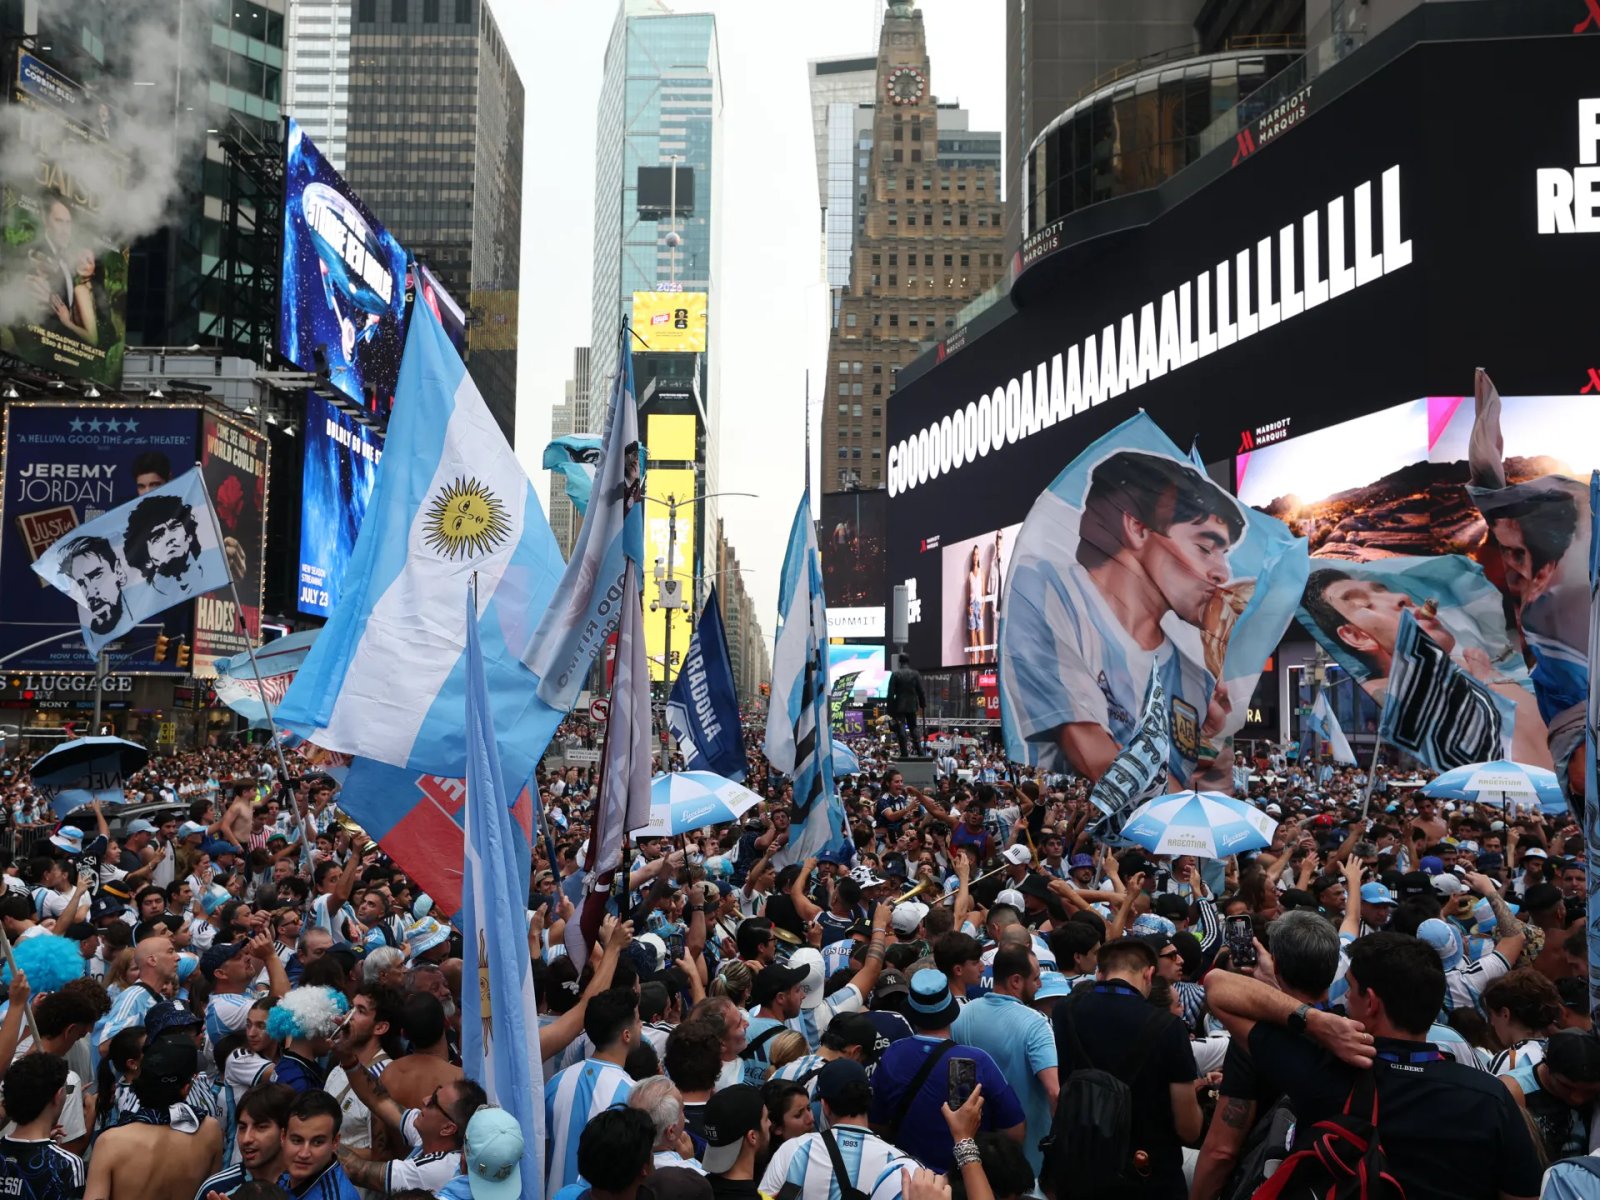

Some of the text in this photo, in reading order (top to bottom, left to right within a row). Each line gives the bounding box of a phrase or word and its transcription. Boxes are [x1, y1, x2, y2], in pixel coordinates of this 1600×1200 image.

[1259, 86, 1312, 130] MARRIOTT
[1259, 105, 1306, 144] MARQUIS
[1023, 221, 1064, 252] MARRIOTT
[1023, 237, 1058, 265] MARQUIS
[46, 331, 79, 348] BROADWAY
[326, 418, 352, 448] BOLDLY
[352, 434, 361, 454] GO
[1256, 417, 1291, 435] MARRIOTT
[1256, 429, 1287, 445] MARQUIS
[28, 433, 66, 444] HELLUVA
[68, 434, 99, 445] GOOD
[102, 435, 121, 445] TIME
[207, 433, 232, 463] WORLD
[232, 448, 255, 474] COULD
[19, 463, 117, 479] JEREMY
[18, 479, 114, 503] JORDAN
[32, 516, 63, 543] JUST
[300, 586, 329, 607] JULY 23
[197, 596, 235, 633] HADES
[50, 652, 70, 660] NOW
[73, 652, 85, 660] ON
[26, 675, 132, 692] LUGGAGE
[1393, 630, 1503, 771] 10
[1167, 838, 1207, 849] ARGENTINA
[1390, 1063, 1424, 1072] GILBERT
